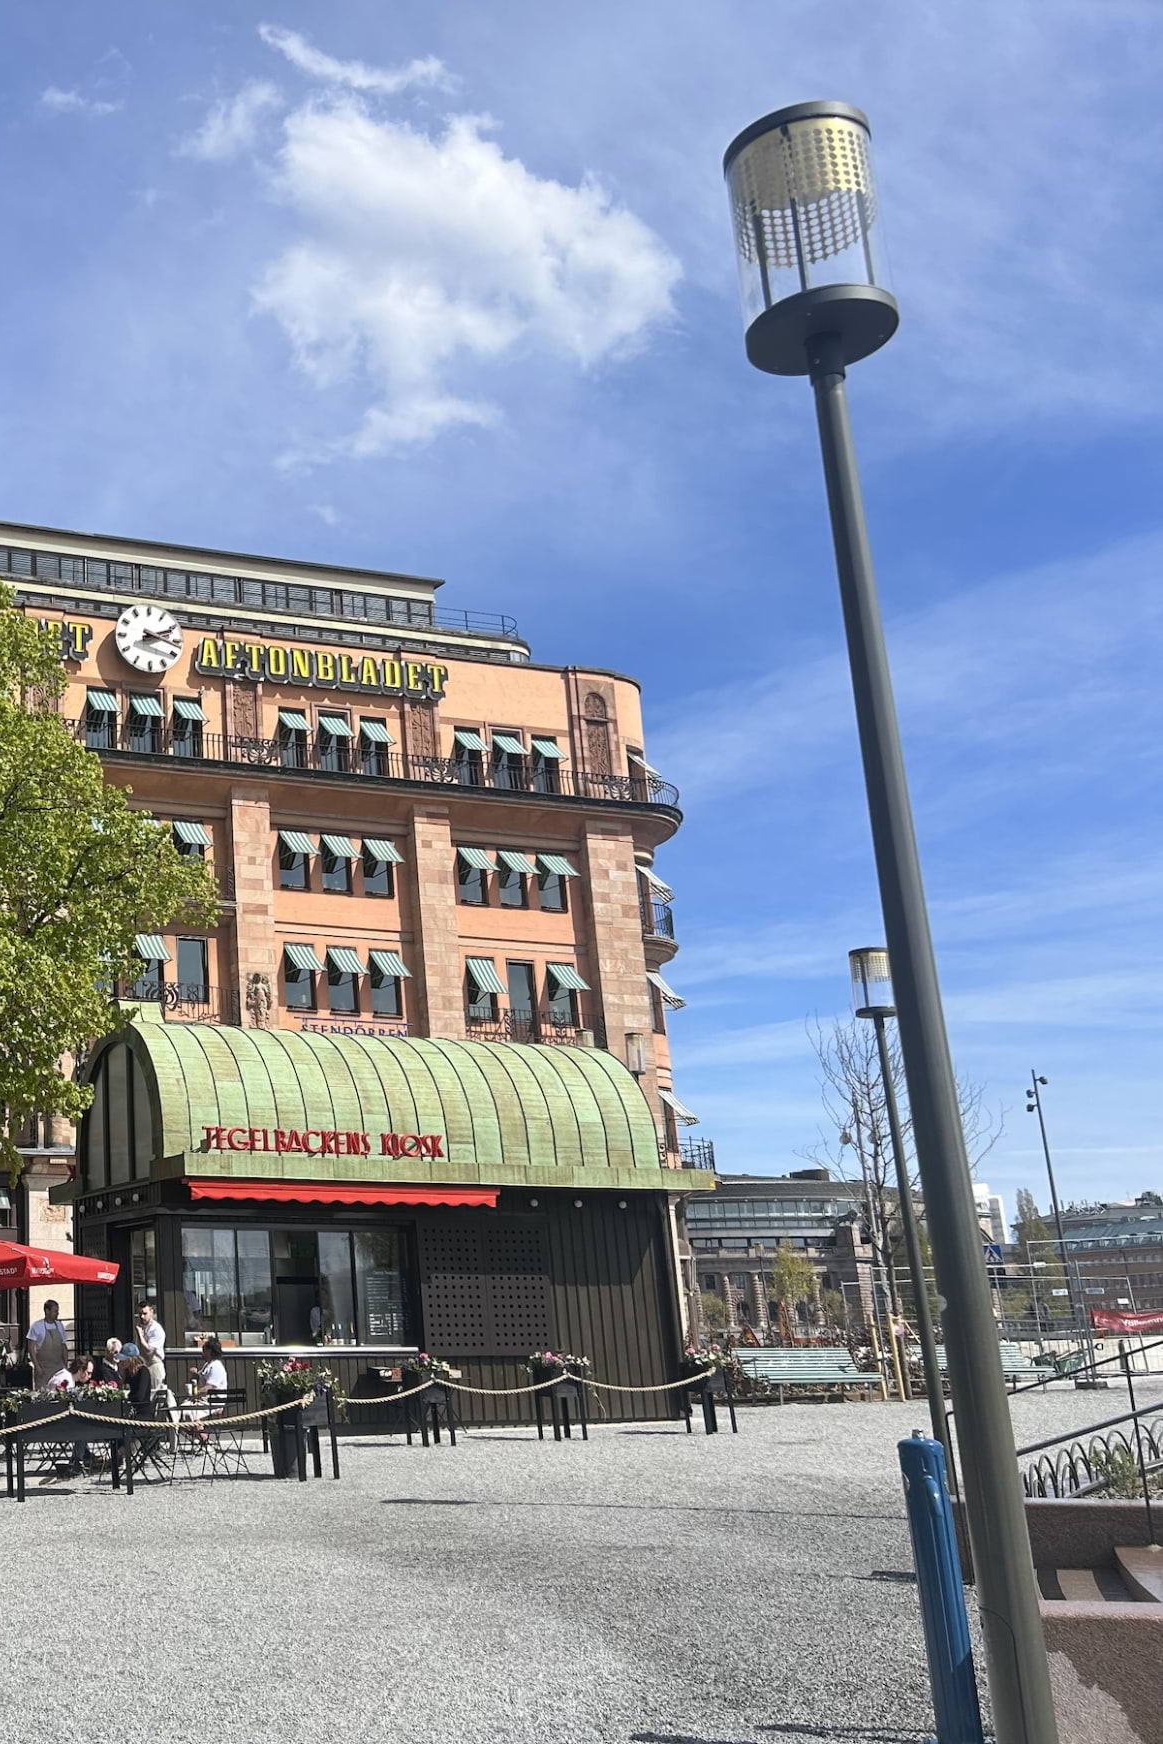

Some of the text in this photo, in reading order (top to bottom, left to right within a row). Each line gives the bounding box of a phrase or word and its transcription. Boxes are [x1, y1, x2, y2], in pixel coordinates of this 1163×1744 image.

[198, 636, 448, 697] AFTONBLADET
[201, 1125, 445, 1157] TEGELBACKENS KIOSK
